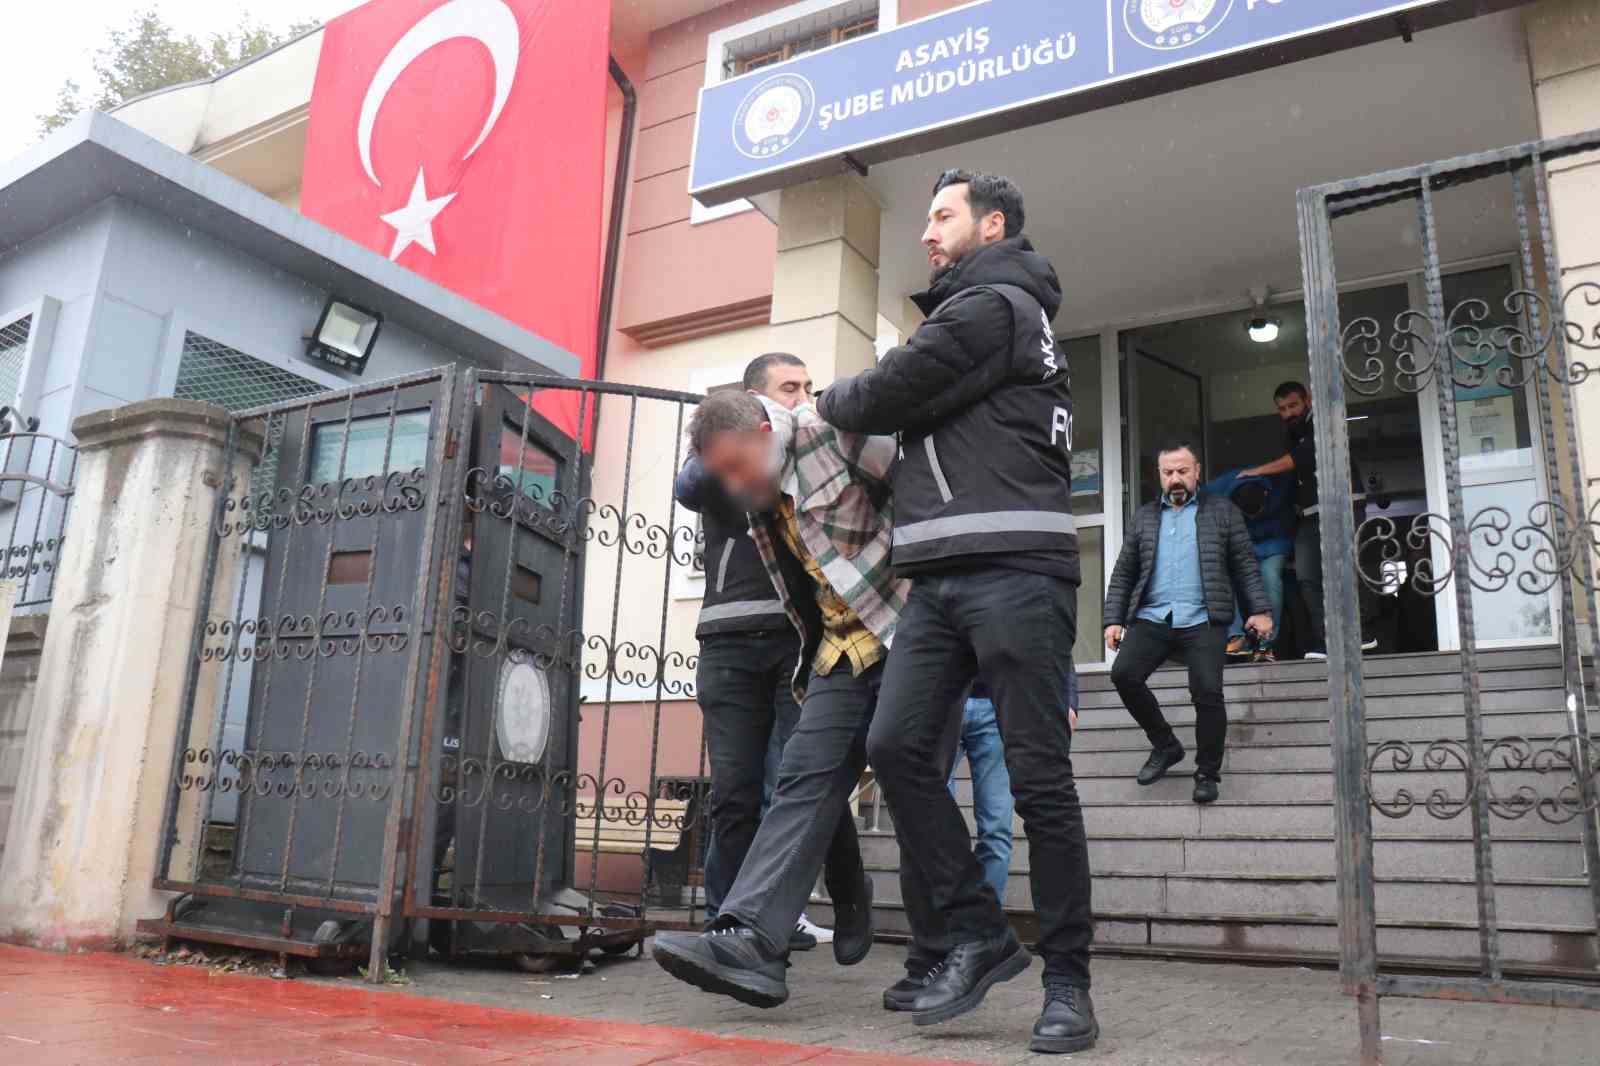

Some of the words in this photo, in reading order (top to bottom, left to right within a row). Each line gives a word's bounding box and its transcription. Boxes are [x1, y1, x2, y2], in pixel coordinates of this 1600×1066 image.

[818, 88, 885, 131] ŞUBE
[890, 31, 1077, 106] MÜDÜRLÜĞÜ
[895, 26, 991, 73] ASAYİŞ
